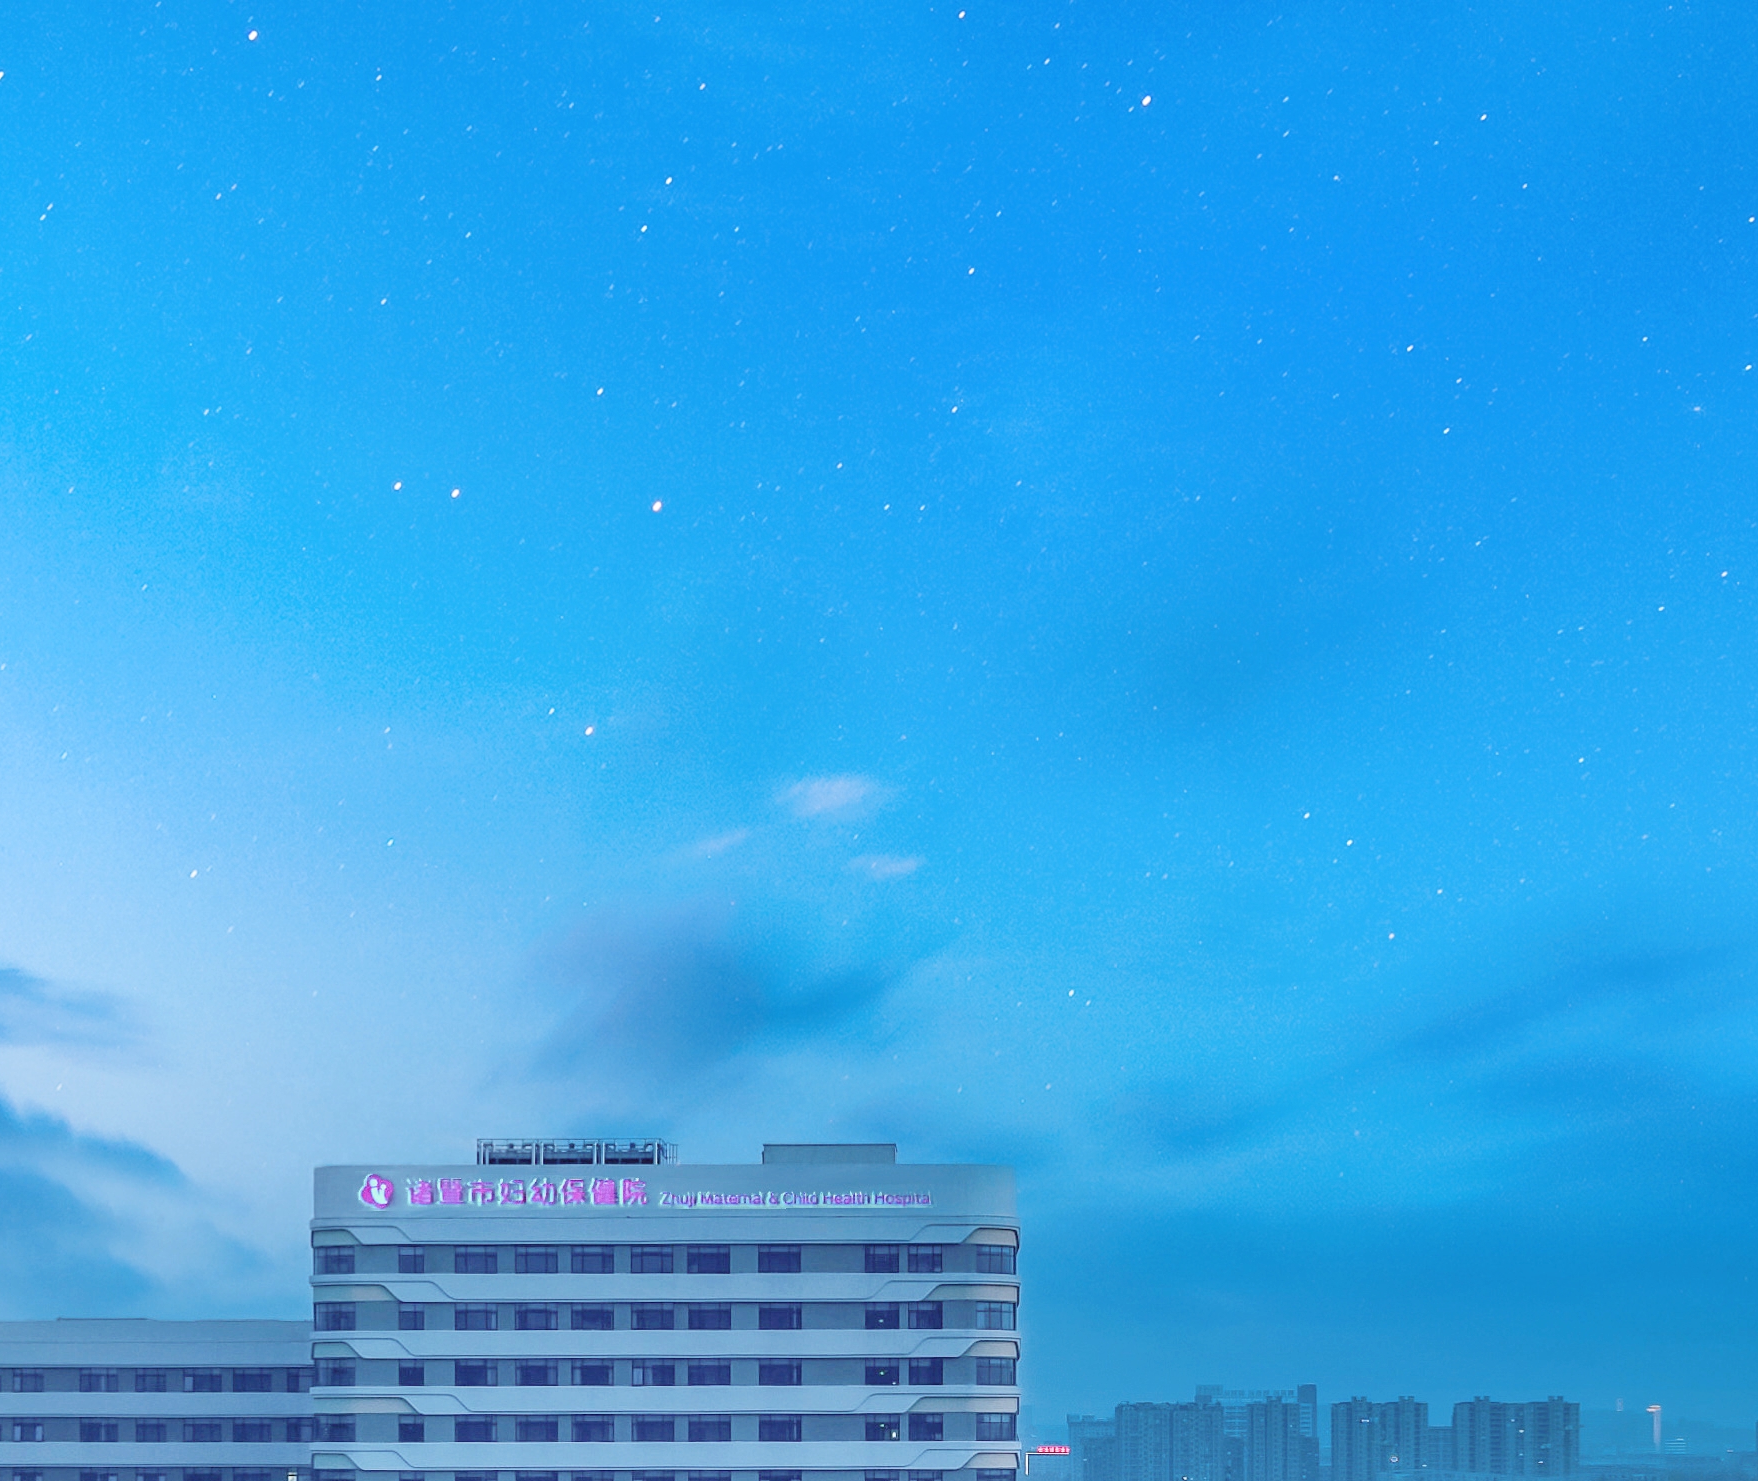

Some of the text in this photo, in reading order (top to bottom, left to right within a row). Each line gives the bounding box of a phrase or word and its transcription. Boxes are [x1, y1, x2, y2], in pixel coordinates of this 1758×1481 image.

[404, 1176, 650, 1207] 诸暨市妇幼保健院
[822, 1191, 870, 1206] Health
[876, 1191, 933, 1208] Hospital
